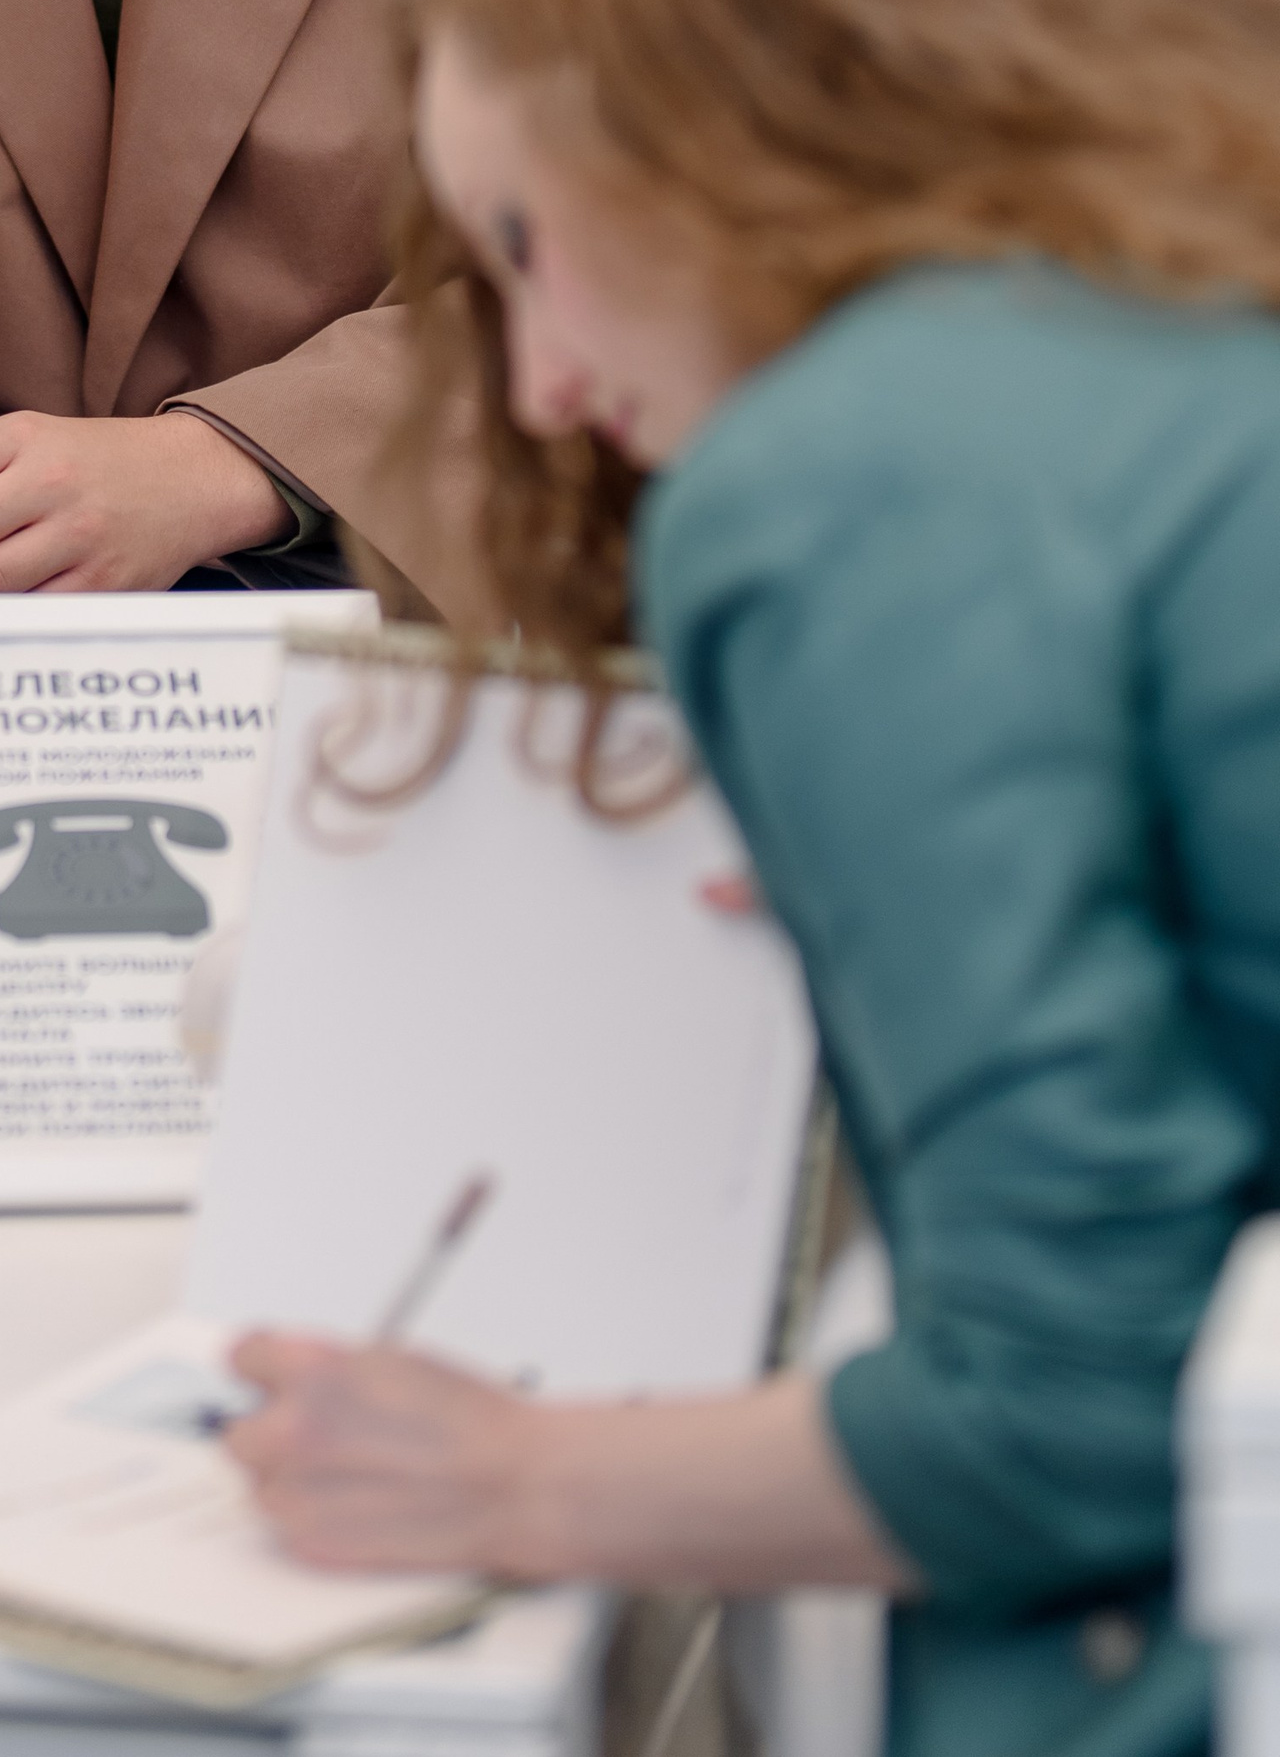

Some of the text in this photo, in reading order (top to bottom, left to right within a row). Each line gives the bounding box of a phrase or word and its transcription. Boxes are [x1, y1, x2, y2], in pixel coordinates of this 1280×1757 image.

[37, 744, 258, 768] МОЛОДОЖЕНАМ
[35, 763, 204, 785] ПОЖЕЛАНИЯ
[76, 954, 195, 976] БОЛЬШУ
